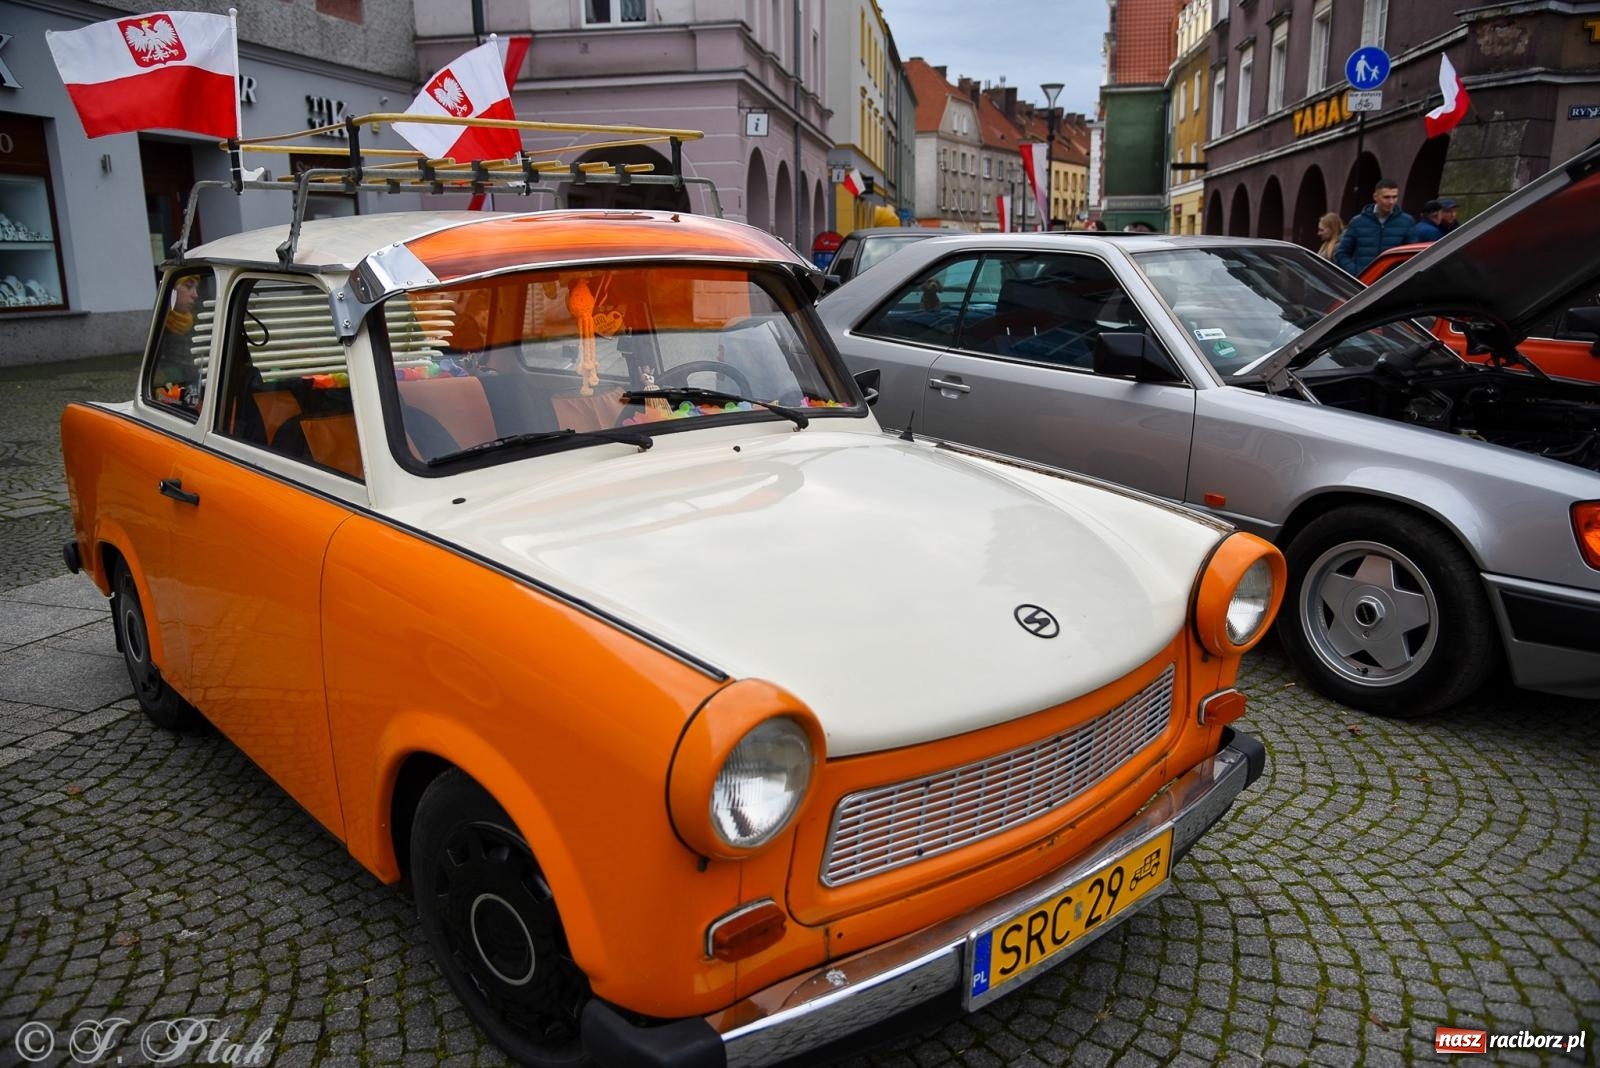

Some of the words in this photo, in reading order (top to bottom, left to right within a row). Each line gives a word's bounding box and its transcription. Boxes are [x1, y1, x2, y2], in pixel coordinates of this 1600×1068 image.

[998, 896, 1073, 976] SRC
[1084, 866, 1125, 930] 29
[973, 970, 987, 988] PL
